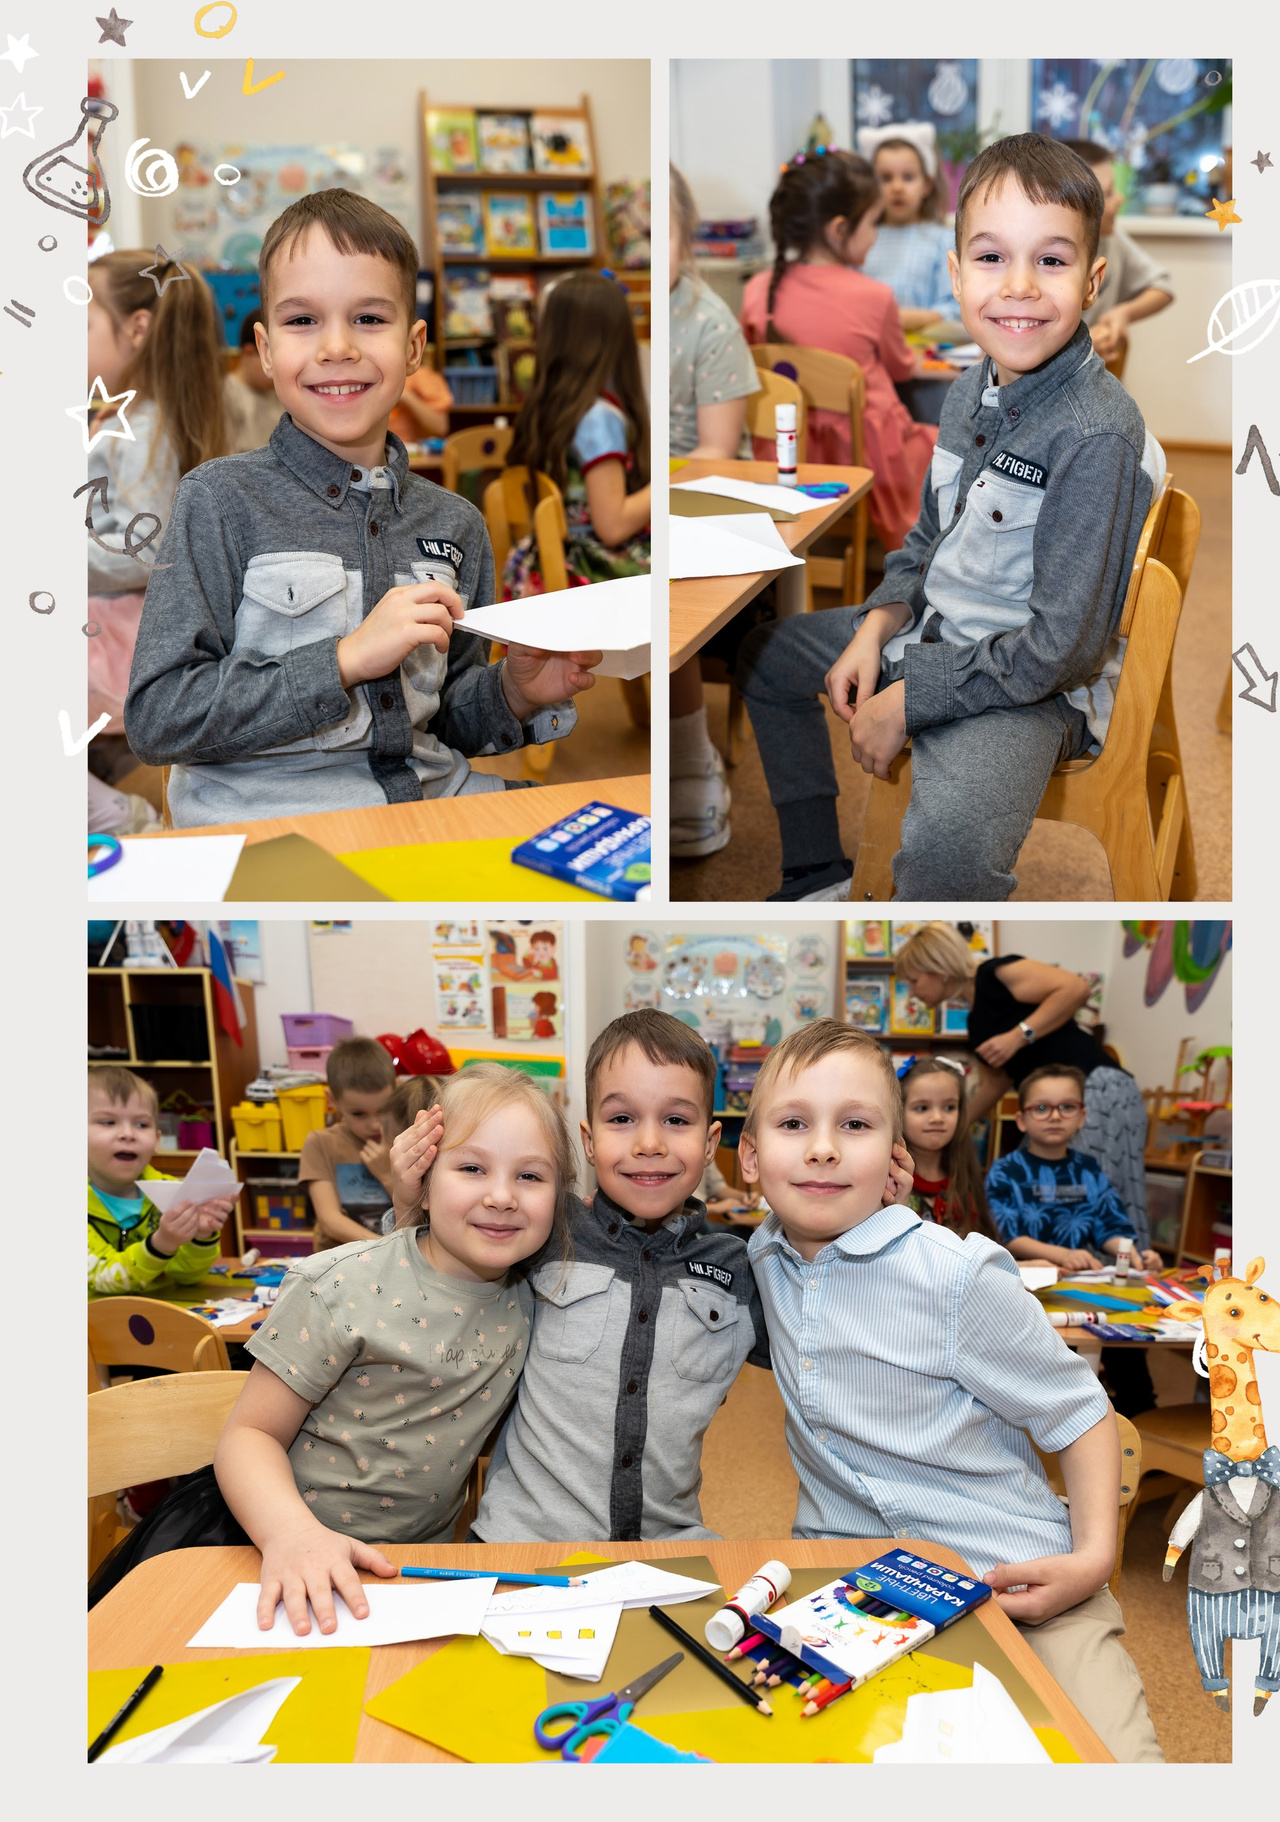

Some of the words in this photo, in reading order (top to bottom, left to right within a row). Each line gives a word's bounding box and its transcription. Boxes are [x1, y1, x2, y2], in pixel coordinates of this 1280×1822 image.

[689, 1261, 732, 1287] HILFIGER
[870, 1562, 966, 1607] КАРАНДАШИ
[898, 1564, 928, 1580] pencils
[923, 1575, 955, 1591] coloured
[875, 1573, 939, 1605] ЦВЕТНЫЕ
